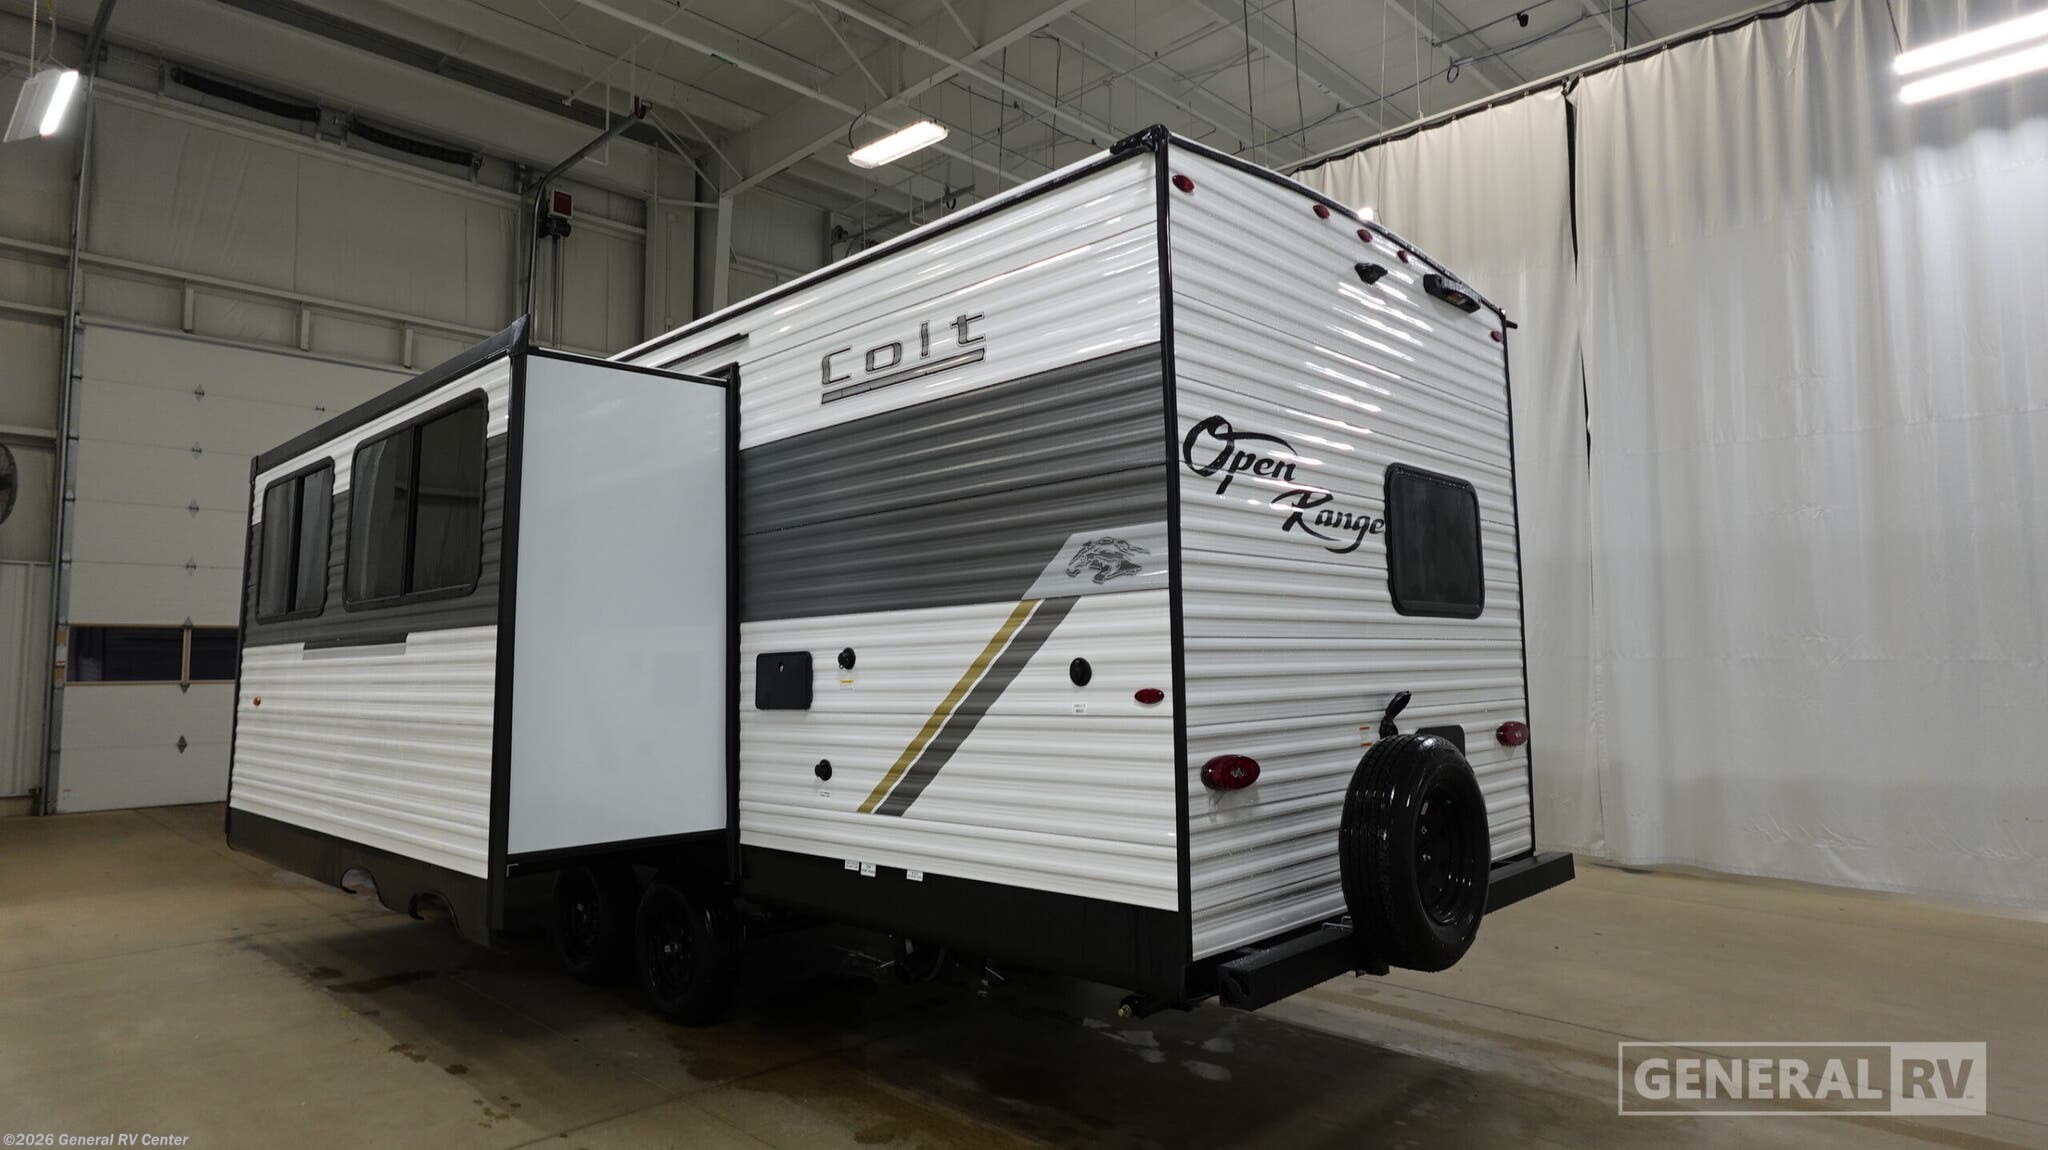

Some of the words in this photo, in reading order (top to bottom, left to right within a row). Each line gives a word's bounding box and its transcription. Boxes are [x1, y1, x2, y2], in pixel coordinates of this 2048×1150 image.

[821, 313, 985, 385] Colt
[1183, 415, 1298, 495] Open
[1271, 489, 1385, 554] Range
